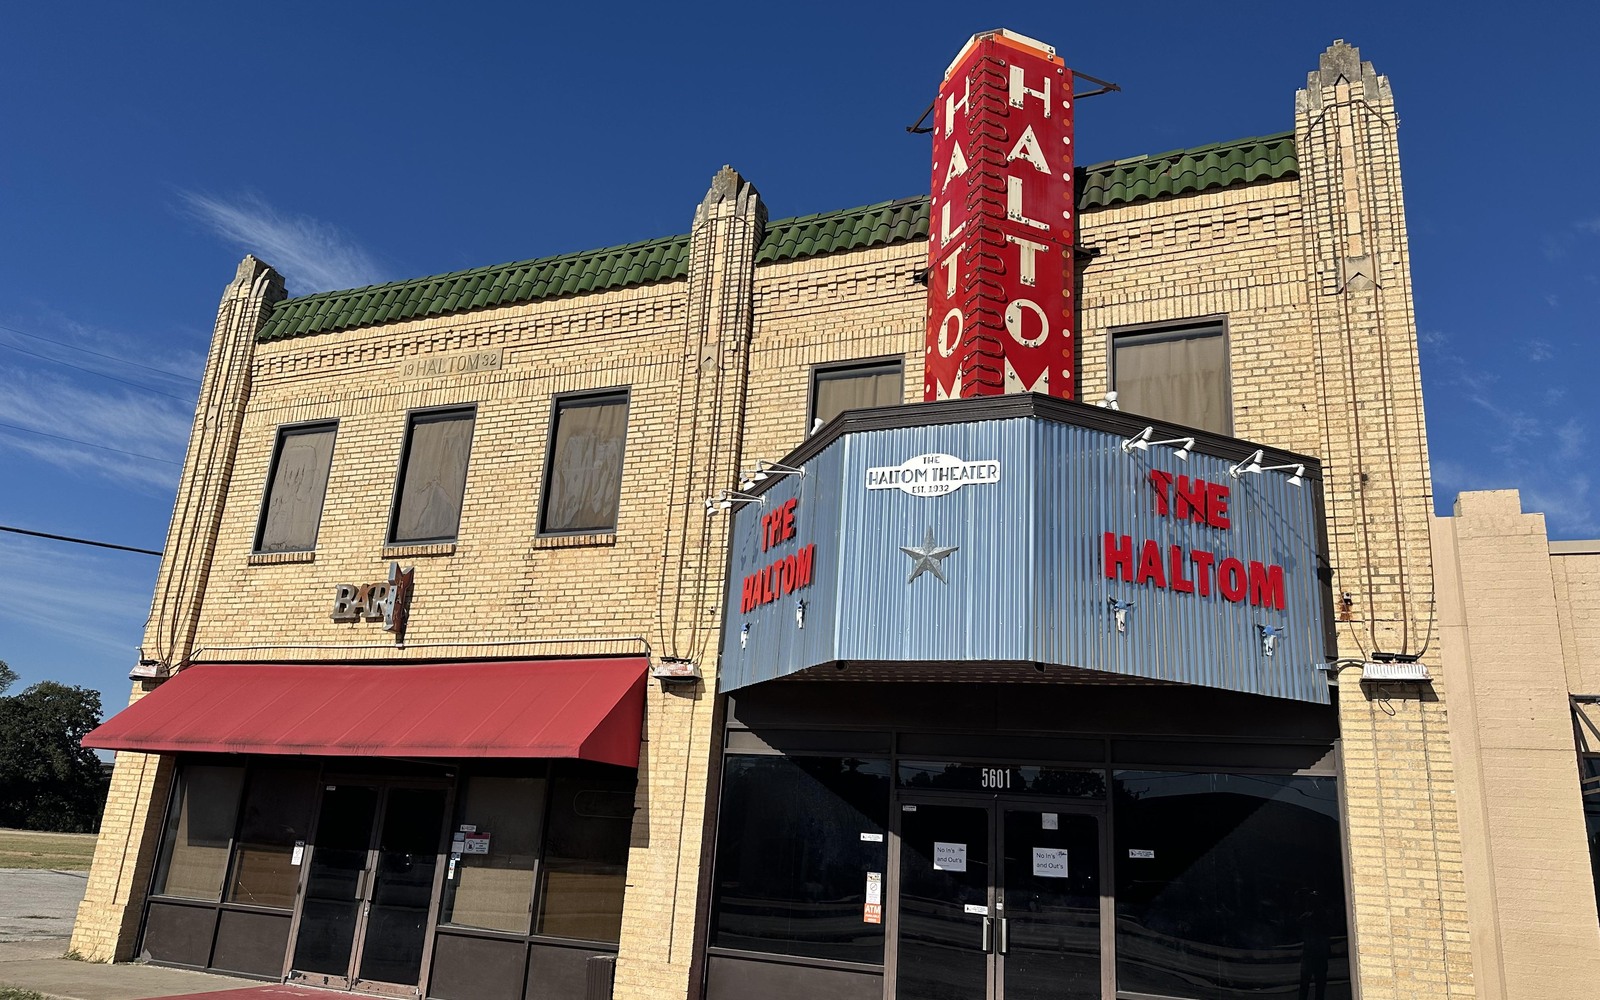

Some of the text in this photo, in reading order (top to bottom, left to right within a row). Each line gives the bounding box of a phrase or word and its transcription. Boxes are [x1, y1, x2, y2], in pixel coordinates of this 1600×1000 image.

[1004, 64, 1051, 394] HALTOM
[414, 353, 481, 378] HALTOM
[481, 353, 498, 367] 32
[869, 465, 997, 485] HALTOM THEATER
[923, 456, 940, 465] THE
[912, 485, 927, 494] EST.
[1150, 468, 1231, 531] THE
[761, 497, 798, 553] THE
[740, 543, 815, 614] HALTOM
[1104, 531, 1285, 611] HALTOM
[330, 583, 392, 623] BAR
[981, 767, 1012, 789] 5601
[865, 904, 881, 915] ATM
